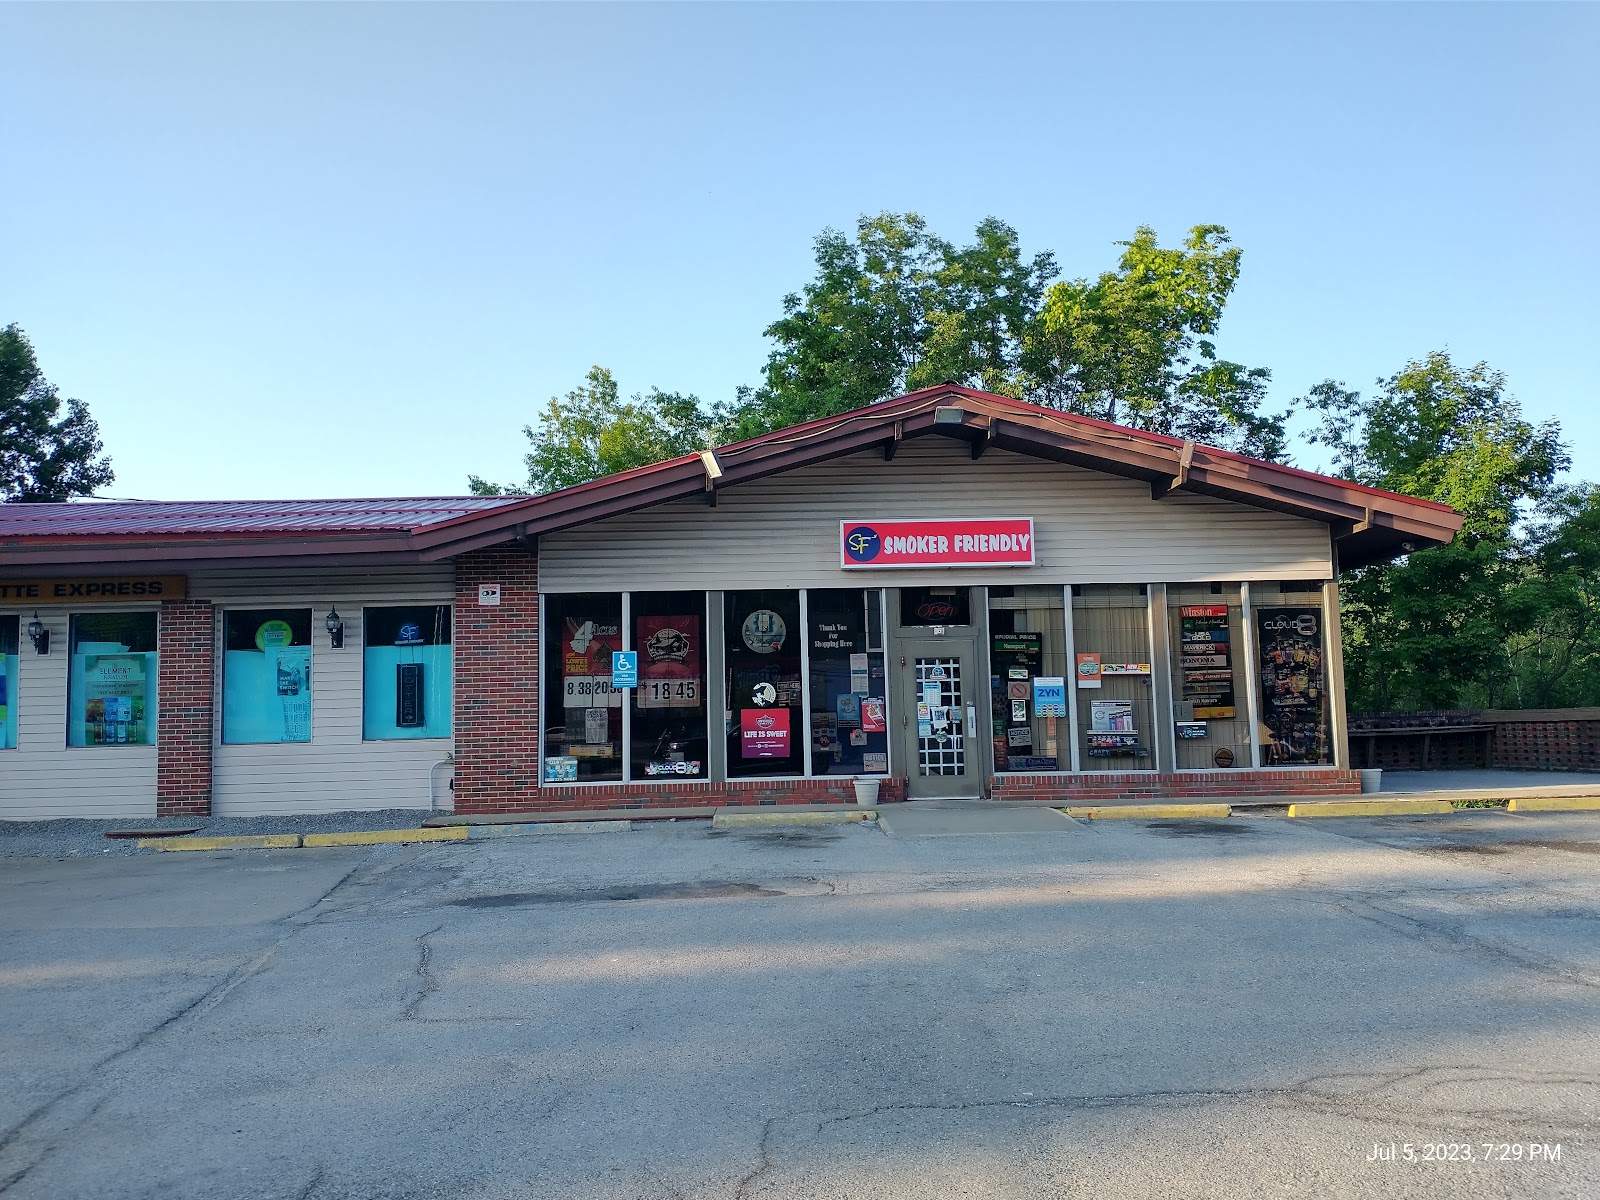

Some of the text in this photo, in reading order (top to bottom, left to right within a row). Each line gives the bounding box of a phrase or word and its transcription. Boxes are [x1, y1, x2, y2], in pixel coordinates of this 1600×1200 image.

[883, 533, 1030, 555] SMOKER FRIENDLY
[53, 581, 163, 597] EXPRESS
[1181, 606, 1213, 617] Winston
[818, 623, 849, 632] Thank You
[1263, 620, 1299, 630] CLOUD
[828, 632, 839, 640] For
[814, 639, 853, 649] Shopping Here
[1003, 642, 1027, 650] Newport
[99, 667, 132, 675] ELEMENT
[1037, 688, 1060, 698] ZYN
[766, 730, 787, 738] SWEET
